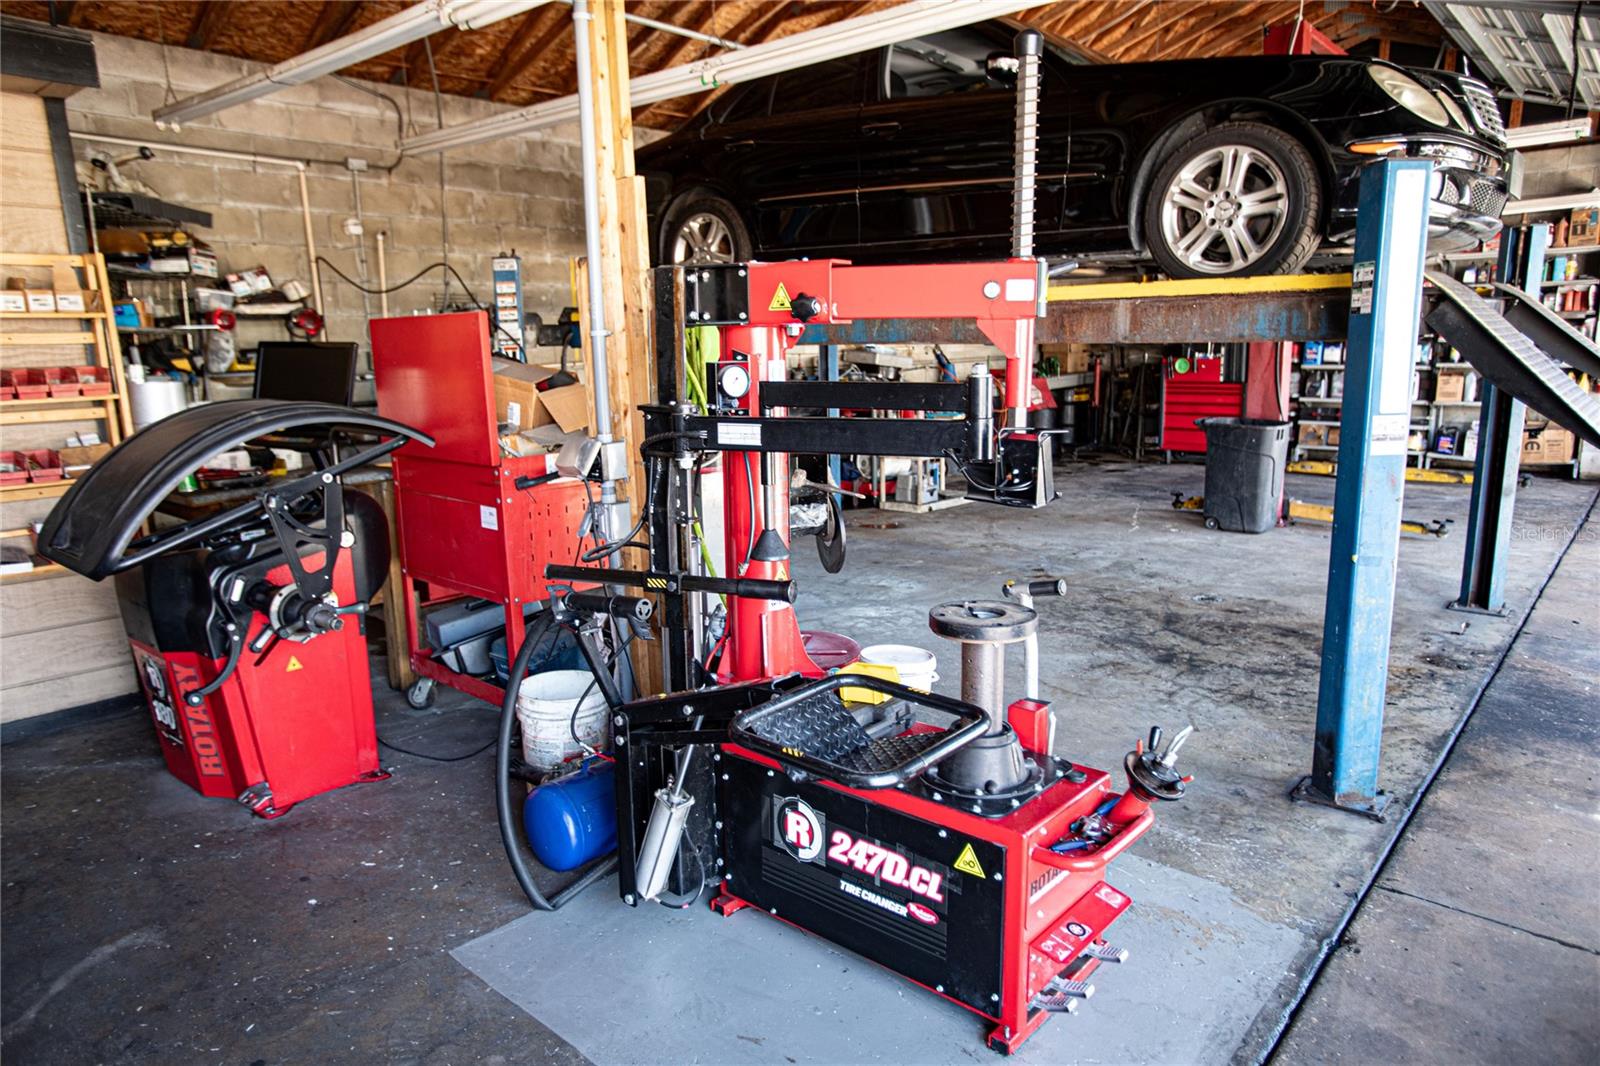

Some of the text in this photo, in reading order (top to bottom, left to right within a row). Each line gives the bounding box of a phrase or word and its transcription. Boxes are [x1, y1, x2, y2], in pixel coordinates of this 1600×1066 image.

[828, 830, 945, 903] 247D.CL
[840, 879, 862, 899] TIRE
[861, 889, 909, 918] CHANGER
